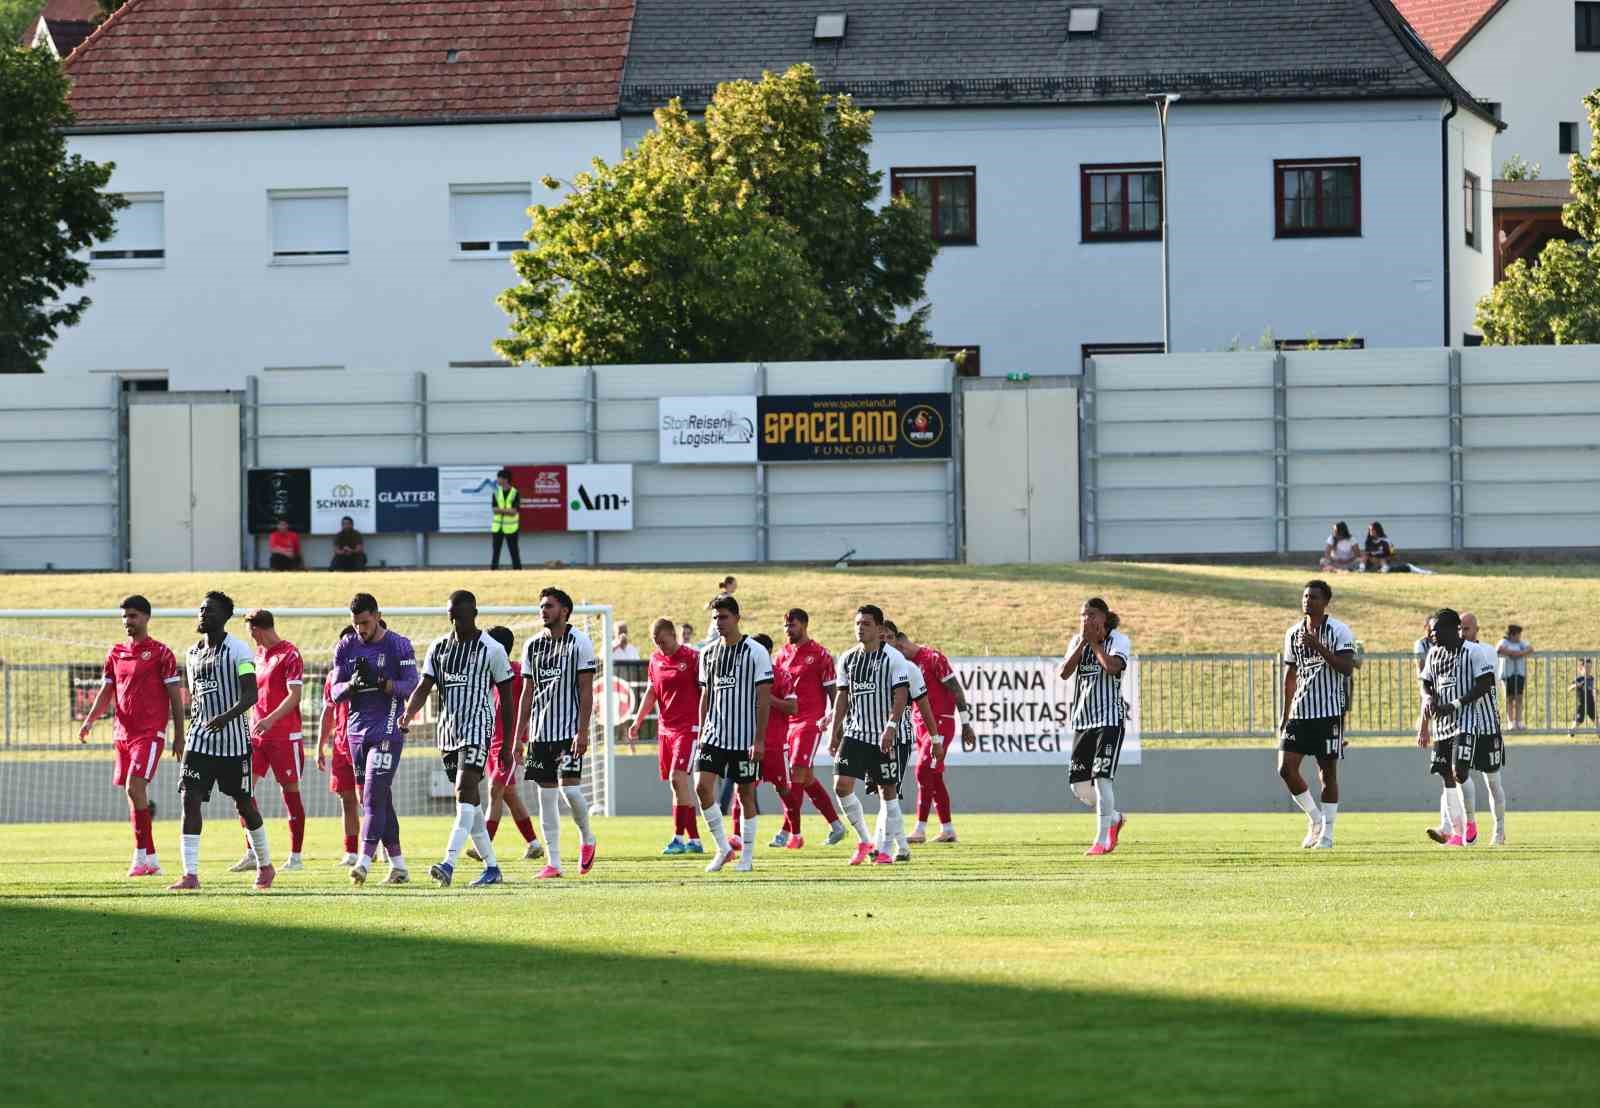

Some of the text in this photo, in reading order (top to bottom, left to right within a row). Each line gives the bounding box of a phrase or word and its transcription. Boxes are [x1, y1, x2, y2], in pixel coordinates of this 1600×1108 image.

[764, 411, 897, 444] SPACELAND
[316, 499, 370, 509] SCHWARZ
[378, 491, 436, 503] GLATTER
[444, 671, 468, 684] beko
[540, 667, 562, 677] beko
[960, 666, 1045, 690] VİYANA
[853, 680, 875, 691] beko
[962, 730, 1061, 753] DERNEĞİ
[373, 752, 392, 769] 99
[465, 747, 487, 767] 35
[1458, 745, 1471, 761] 15
[880, 762, 897, 779] 52
[1093, 757, 1111, 772] 22
